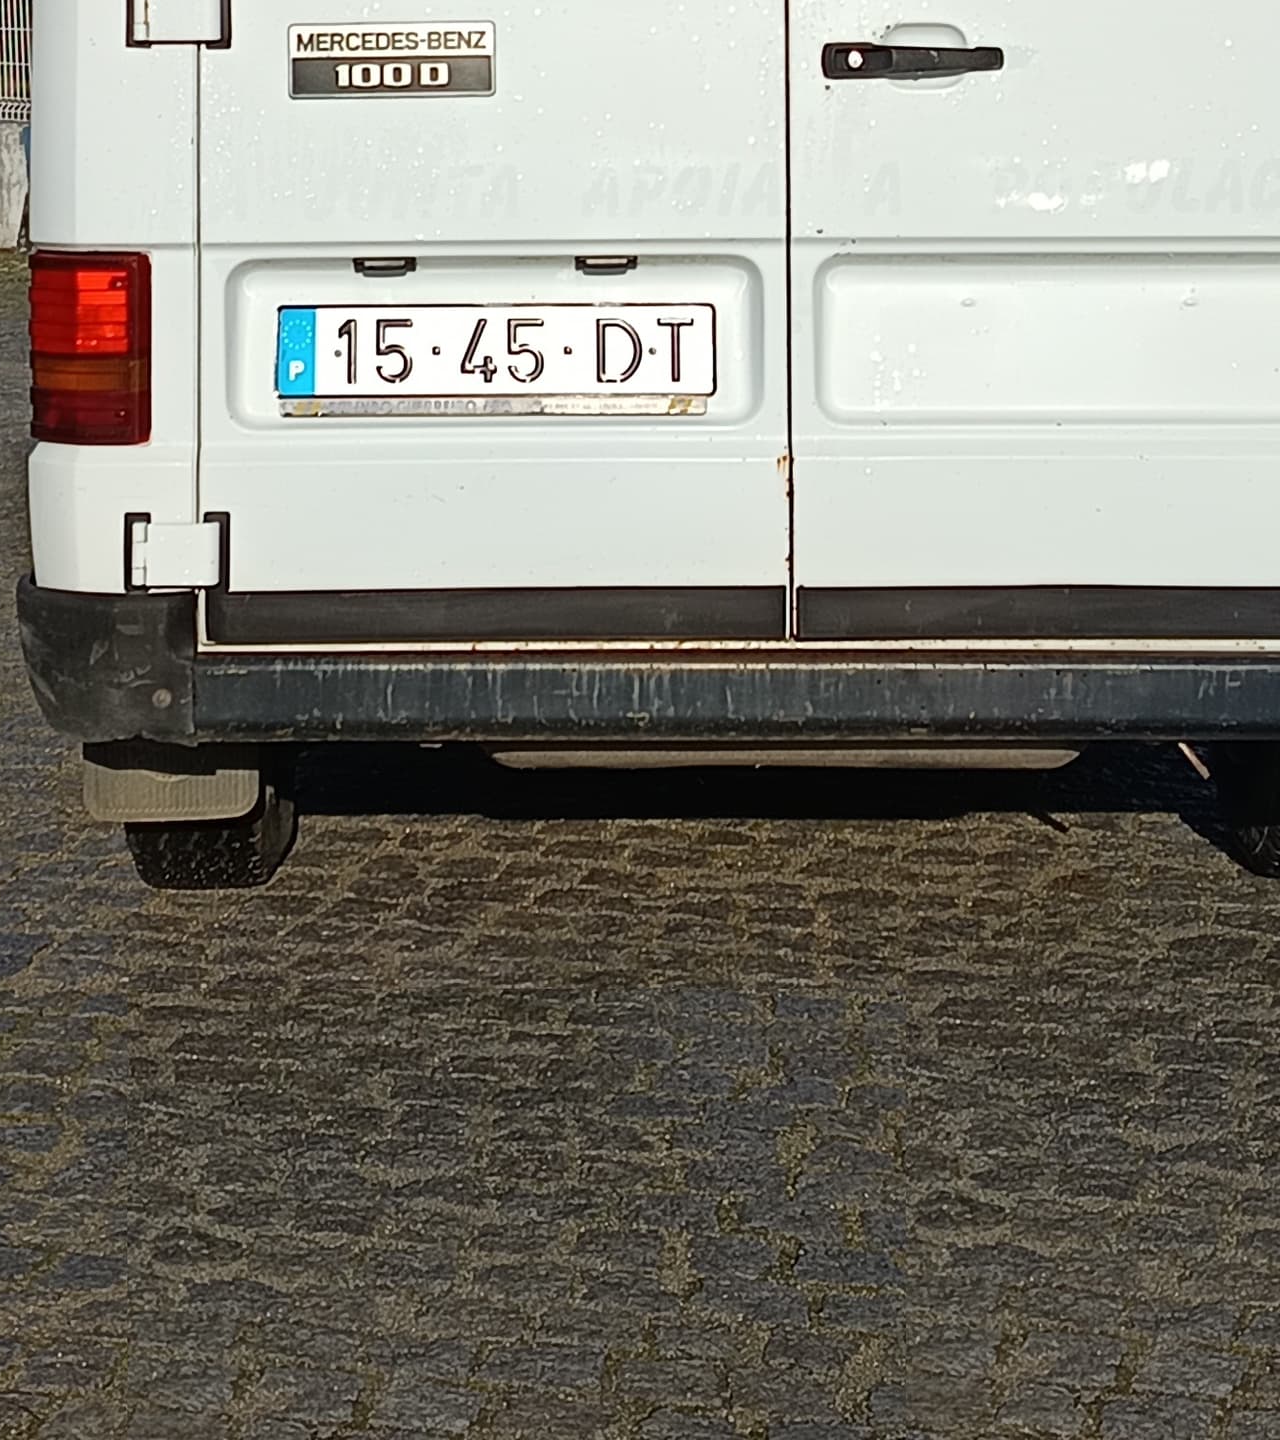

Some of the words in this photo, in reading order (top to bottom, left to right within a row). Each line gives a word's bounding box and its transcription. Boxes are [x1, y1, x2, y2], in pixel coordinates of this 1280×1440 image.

[296, 31, 487, 52] MERCEDES-BENZ
[334, 62, 413, 88] 100
[419, 62, 450, 87] D
[289, 360, 305, 381] P
